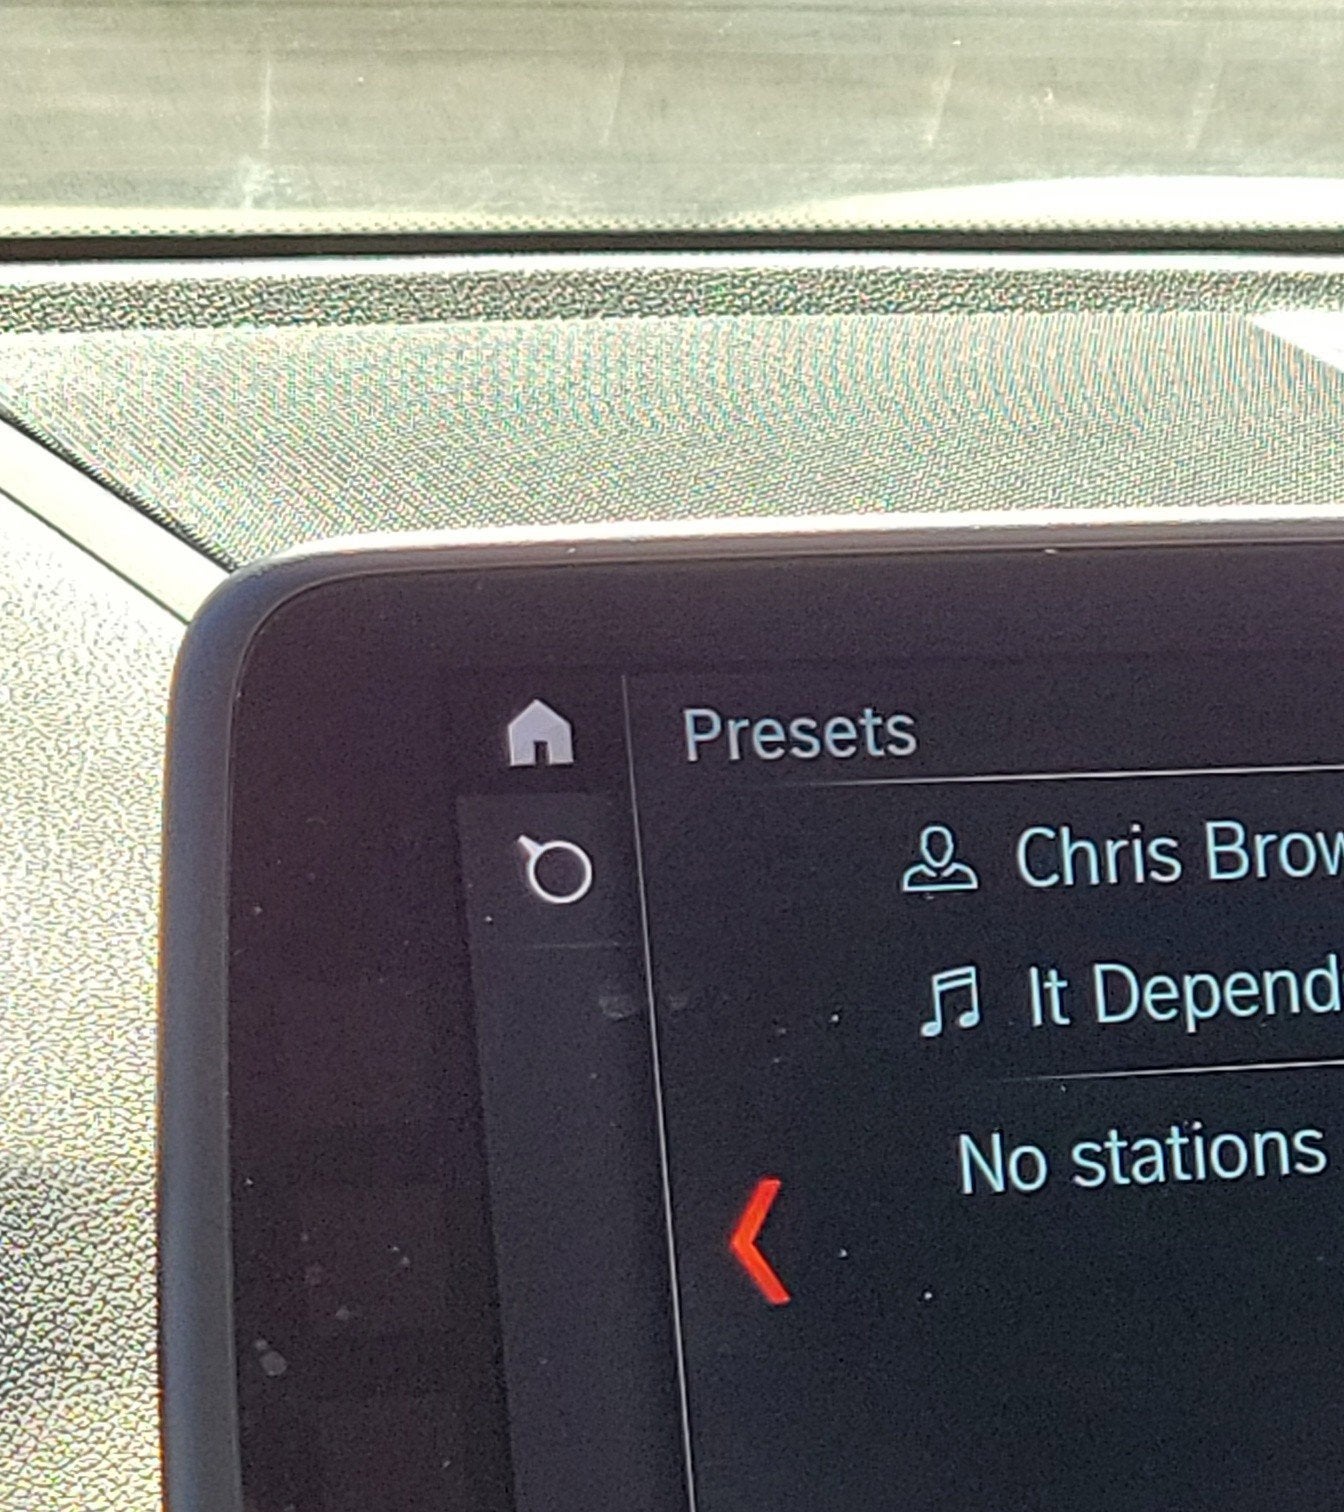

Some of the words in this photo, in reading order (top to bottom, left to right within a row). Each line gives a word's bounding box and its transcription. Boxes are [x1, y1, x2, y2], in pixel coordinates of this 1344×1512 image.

[683, 704, 919, 763] Presets
[1015, 821, 1183, 889] Chris
[1027, 965, 1071, 1028] It
[958, 1131, 1048, 1195] No
[1071, 1120, 1328, 1189] stations
